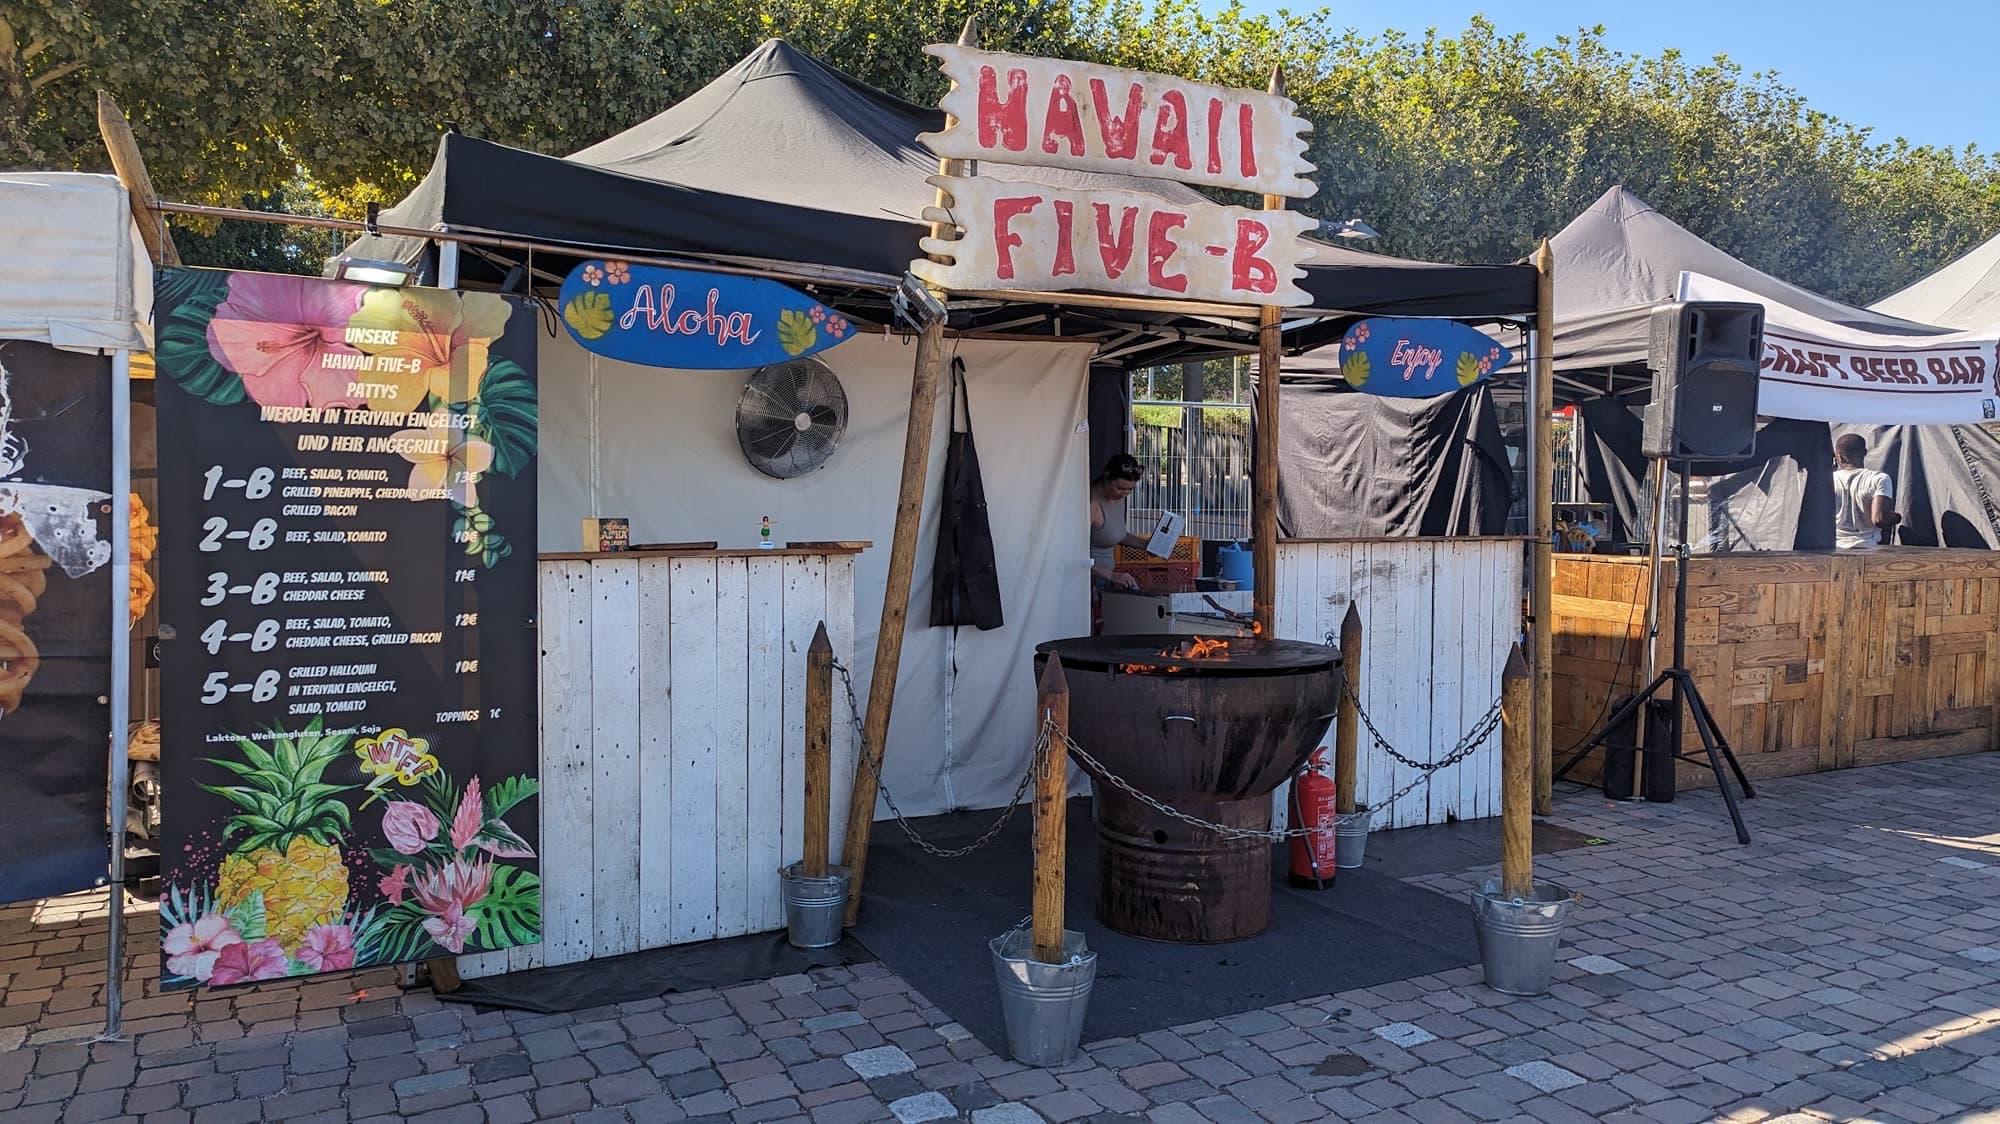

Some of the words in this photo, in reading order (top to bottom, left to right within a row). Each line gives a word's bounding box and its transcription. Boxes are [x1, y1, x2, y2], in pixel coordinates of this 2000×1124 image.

[977, 65, 1258, 177] HAWAII
[993, 196, 1278, 294] FIVE-B
[619, 284, 762, 346] Aloha
[345, 328, 399, 345] UNSERE
[321, 353, 374, 371] HAWAII
[376, 356, 422, 374] FIVE-B
[1391, 339, 1443, 381] Enjoy
[1850, 356, 1928, 384] BEER
[1927, 355, 1985, 384] BAR
[346, 382, 399, 399] PATTYS
[260, 406, 322, 423] WERDEN
[323, 408, 341, 424] IN
[344, 409, 404, 427] TERIYAKI
[406, 411, 478, 429] EINGELEGT
[297, 434, 329, 451] UND
[366, 437, 449, 455] ANGEGRILLT
[202, 465, 275, 501] 1-B
[281, 467, 308, 480] BEEF,
[309, 468, 344, 481] SALAD,
[346, 469, 389, 482] TOMATO,
[282, 486, 321, 498] GRILLED
[323, 487, 374, 500] PINEAPPLE,
[375, 488, 418, 500] CHEDDAR
[420, 489, 454, 501] CHEESE,
[282, 504, 322, 516] GRILLED
[323, 505, 359, 517] BACON
[198, 516, 278, 552] 2-B
[285, 531, 312, 544] BEEF,
[283, 571, 308, 584] BEEF,
[310, 571, 345, 584] SALAD,
[347, 570, 390, 584] TOMATO,
[200, 571, 281, 607] 3-B
[283, 590, 329, 602] CHEDDAR
[330, 589, 366, 601] CHEESE
[285, 618, 311, 631] BEEF,
[313, 616, 347, 630] SALAD,
[350, 616, 392, 629] TOMATO,
[200, 619, 281, 656] 4-B
[285, 636, 331, 648] CHEDDAR
[332, 635, 369, 647] CHEESE,
[371, 633, 409, 645] GRILLED
[410, 632, 443, 644] BACON
[288, 666, 328, 679] GRILLED
[329, 663, 377, 677] HALLOUMI
[201, 669, 281, 705] 5-B
[288, 685, 300, 697] IN
[302, 683, 345, 696] TERIYAKI
[346, 680, 397, 694] EINGELEGT,
[288, 703, 323, 715] SALAD,
[326, 700, 367, 713] TOMATO
[436, 710, 479, 723] TOPPINGS
[361, 724, 382, 735] Soja
